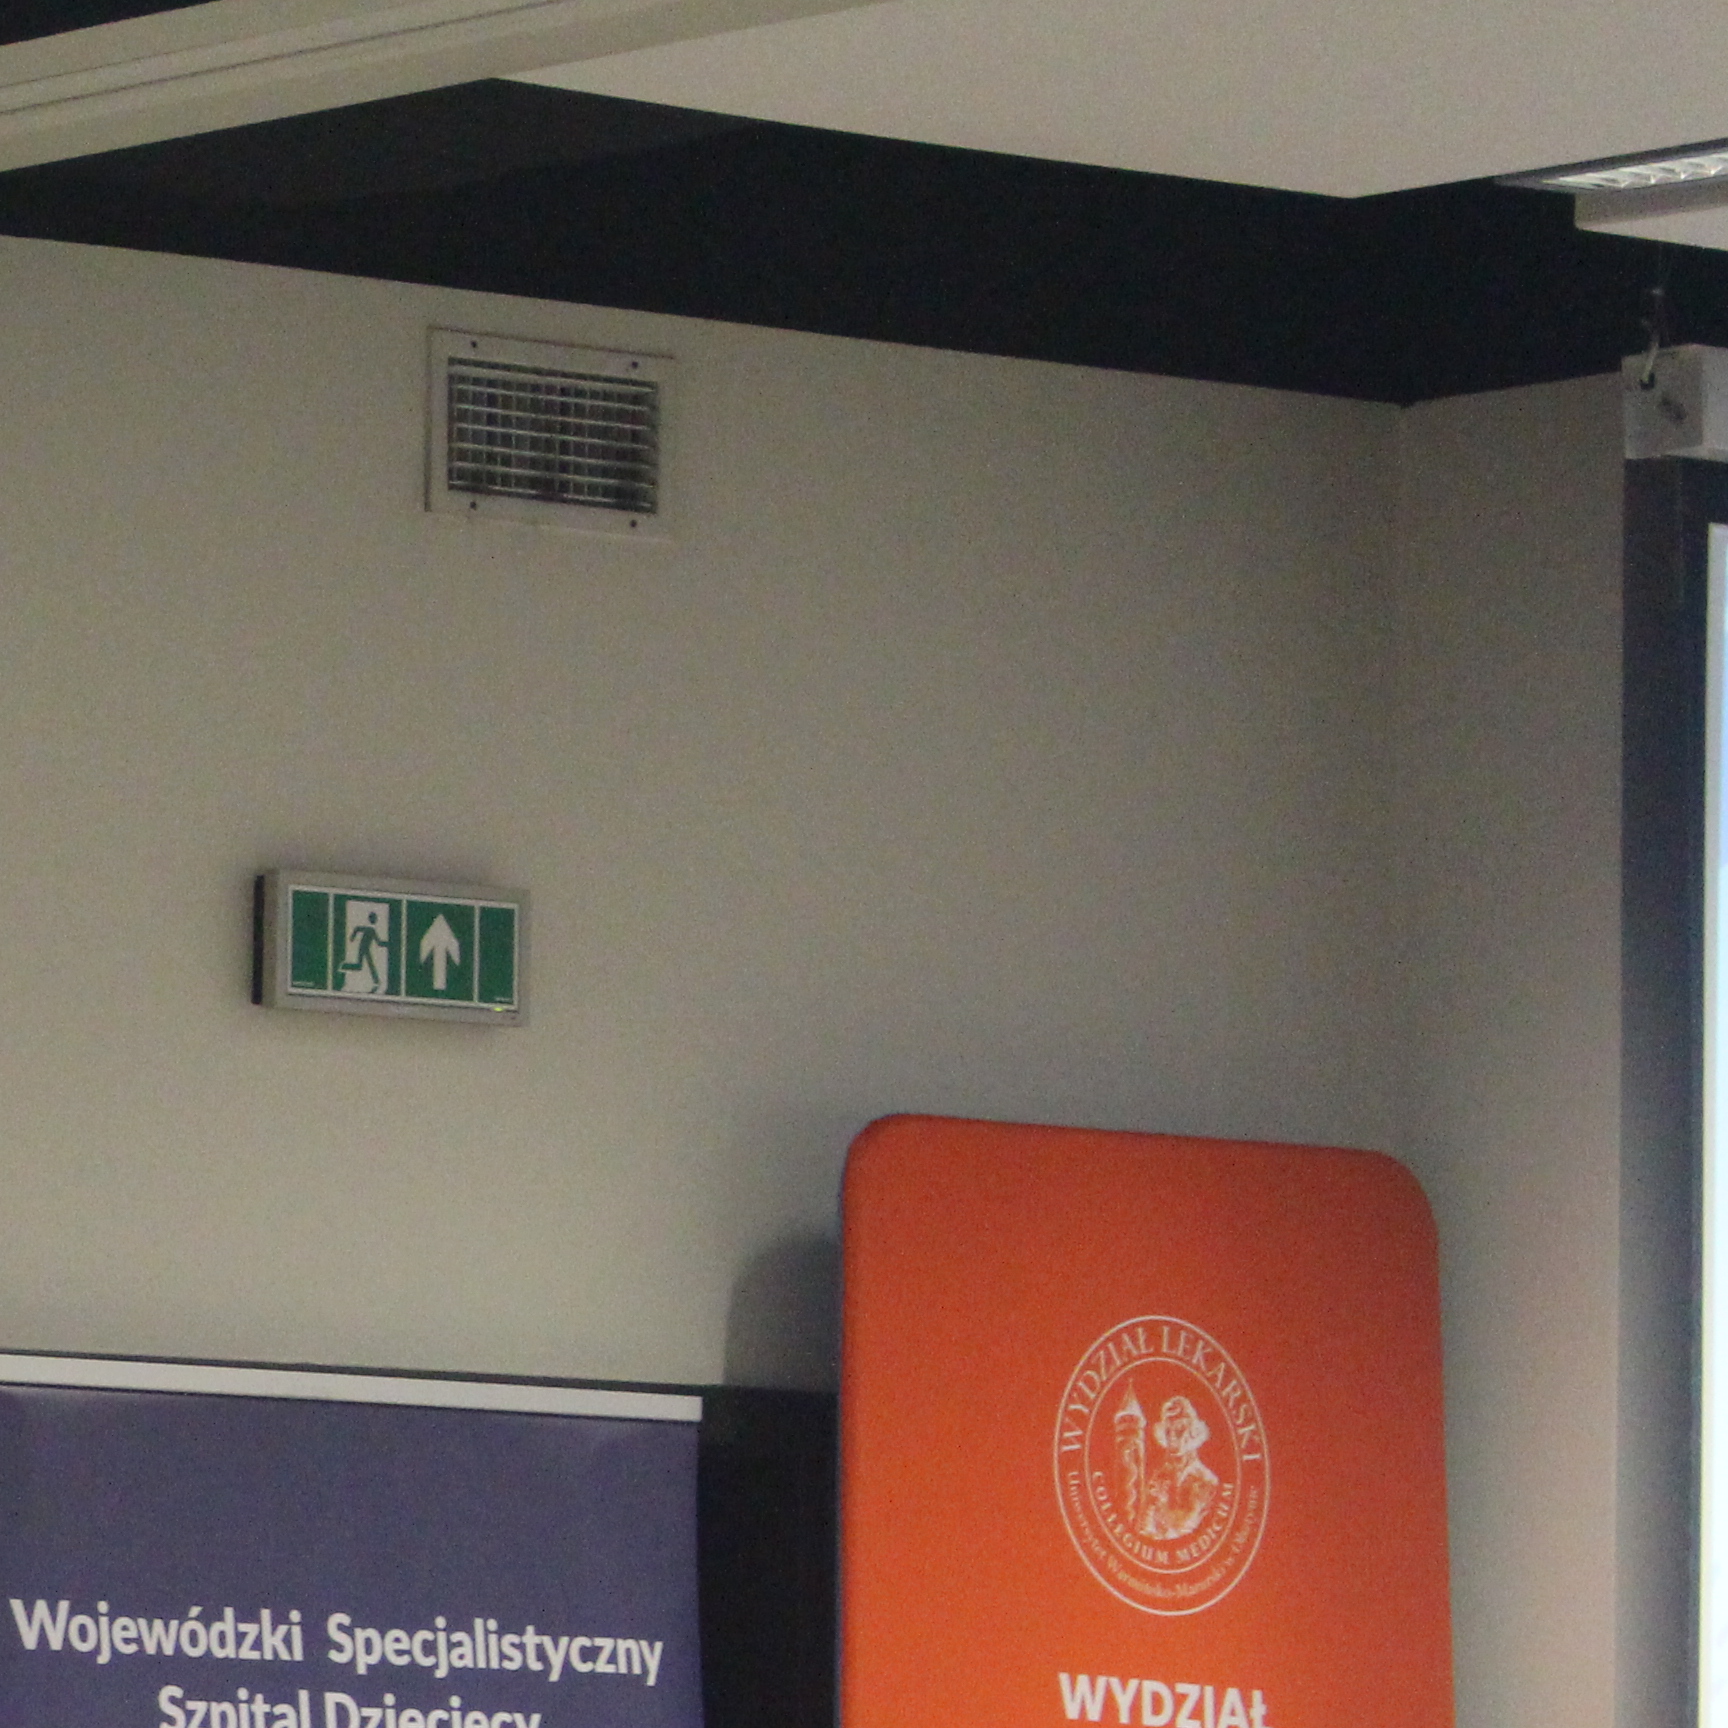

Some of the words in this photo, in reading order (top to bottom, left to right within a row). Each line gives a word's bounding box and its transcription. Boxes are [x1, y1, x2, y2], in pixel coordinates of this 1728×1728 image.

[1061, 1327, 1154, 1451] WYDZIAŁ
[1160, 1325, 1262, 1462] LEKARSKI
[1093, 1471, 1170, 1565] COLLEGIUM
[1176, 1482, 1235, 1564] MEDICUM
[9, 1598, 304, 1665] Wojewódzki
[326, 1612, 664, 1687] Specjalistyczny
